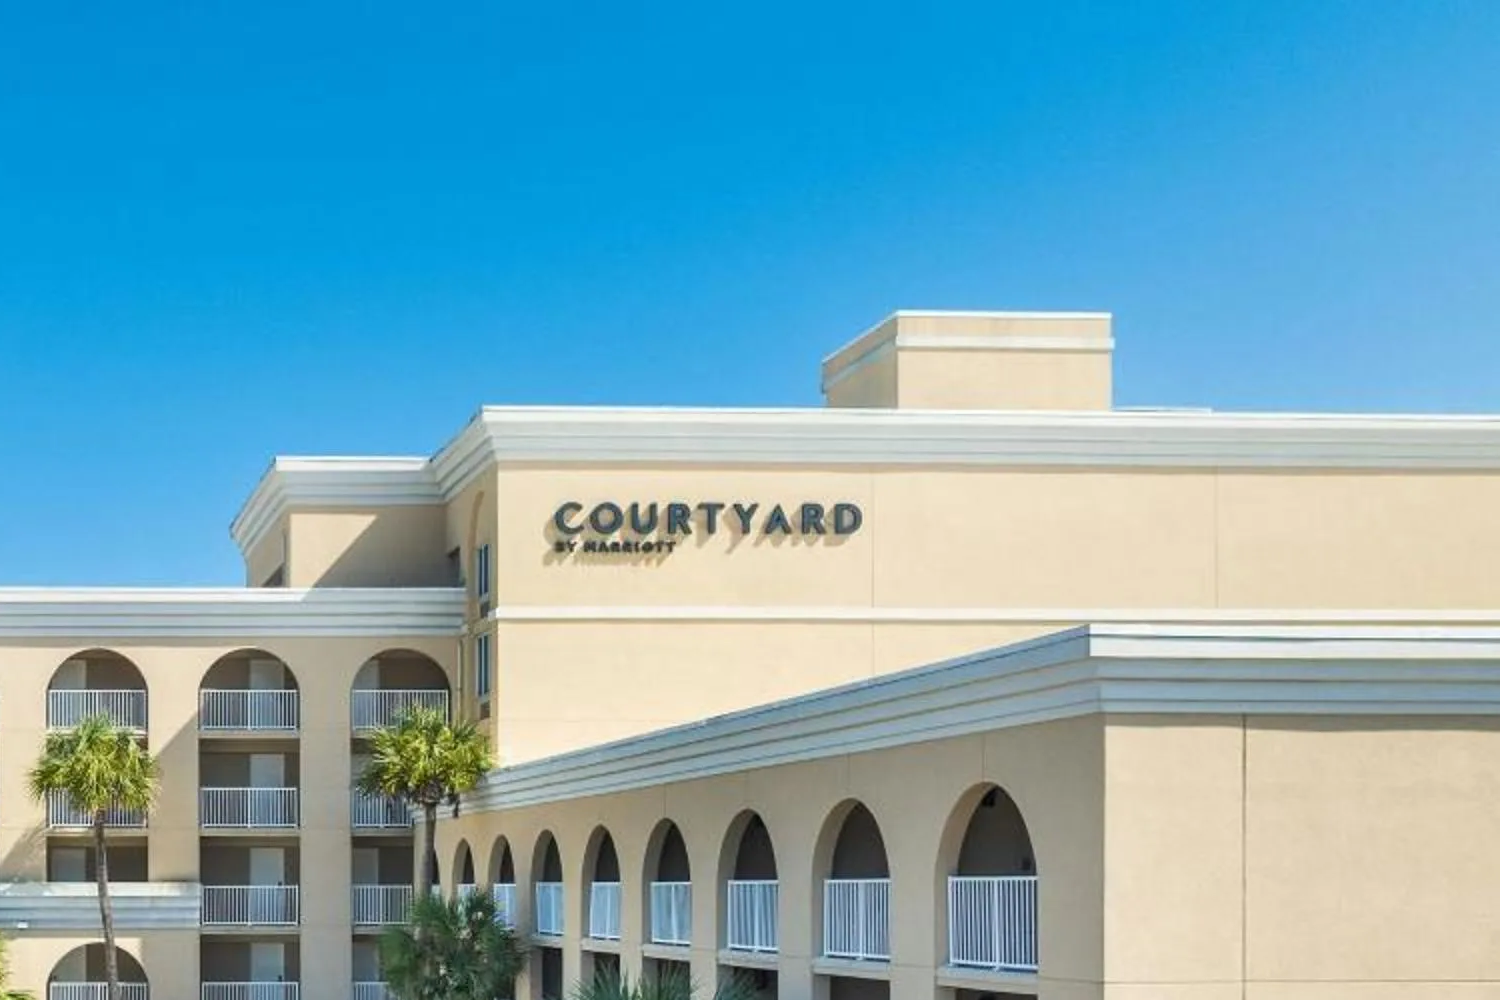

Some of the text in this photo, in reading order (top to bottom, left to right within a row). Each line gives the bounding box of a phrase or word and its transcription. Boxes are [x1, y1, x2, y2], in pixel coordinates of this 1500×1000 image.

[553, 501, 863, 535] COURTYARD
[553, 540, 677, 553] BY MARRIOTT
